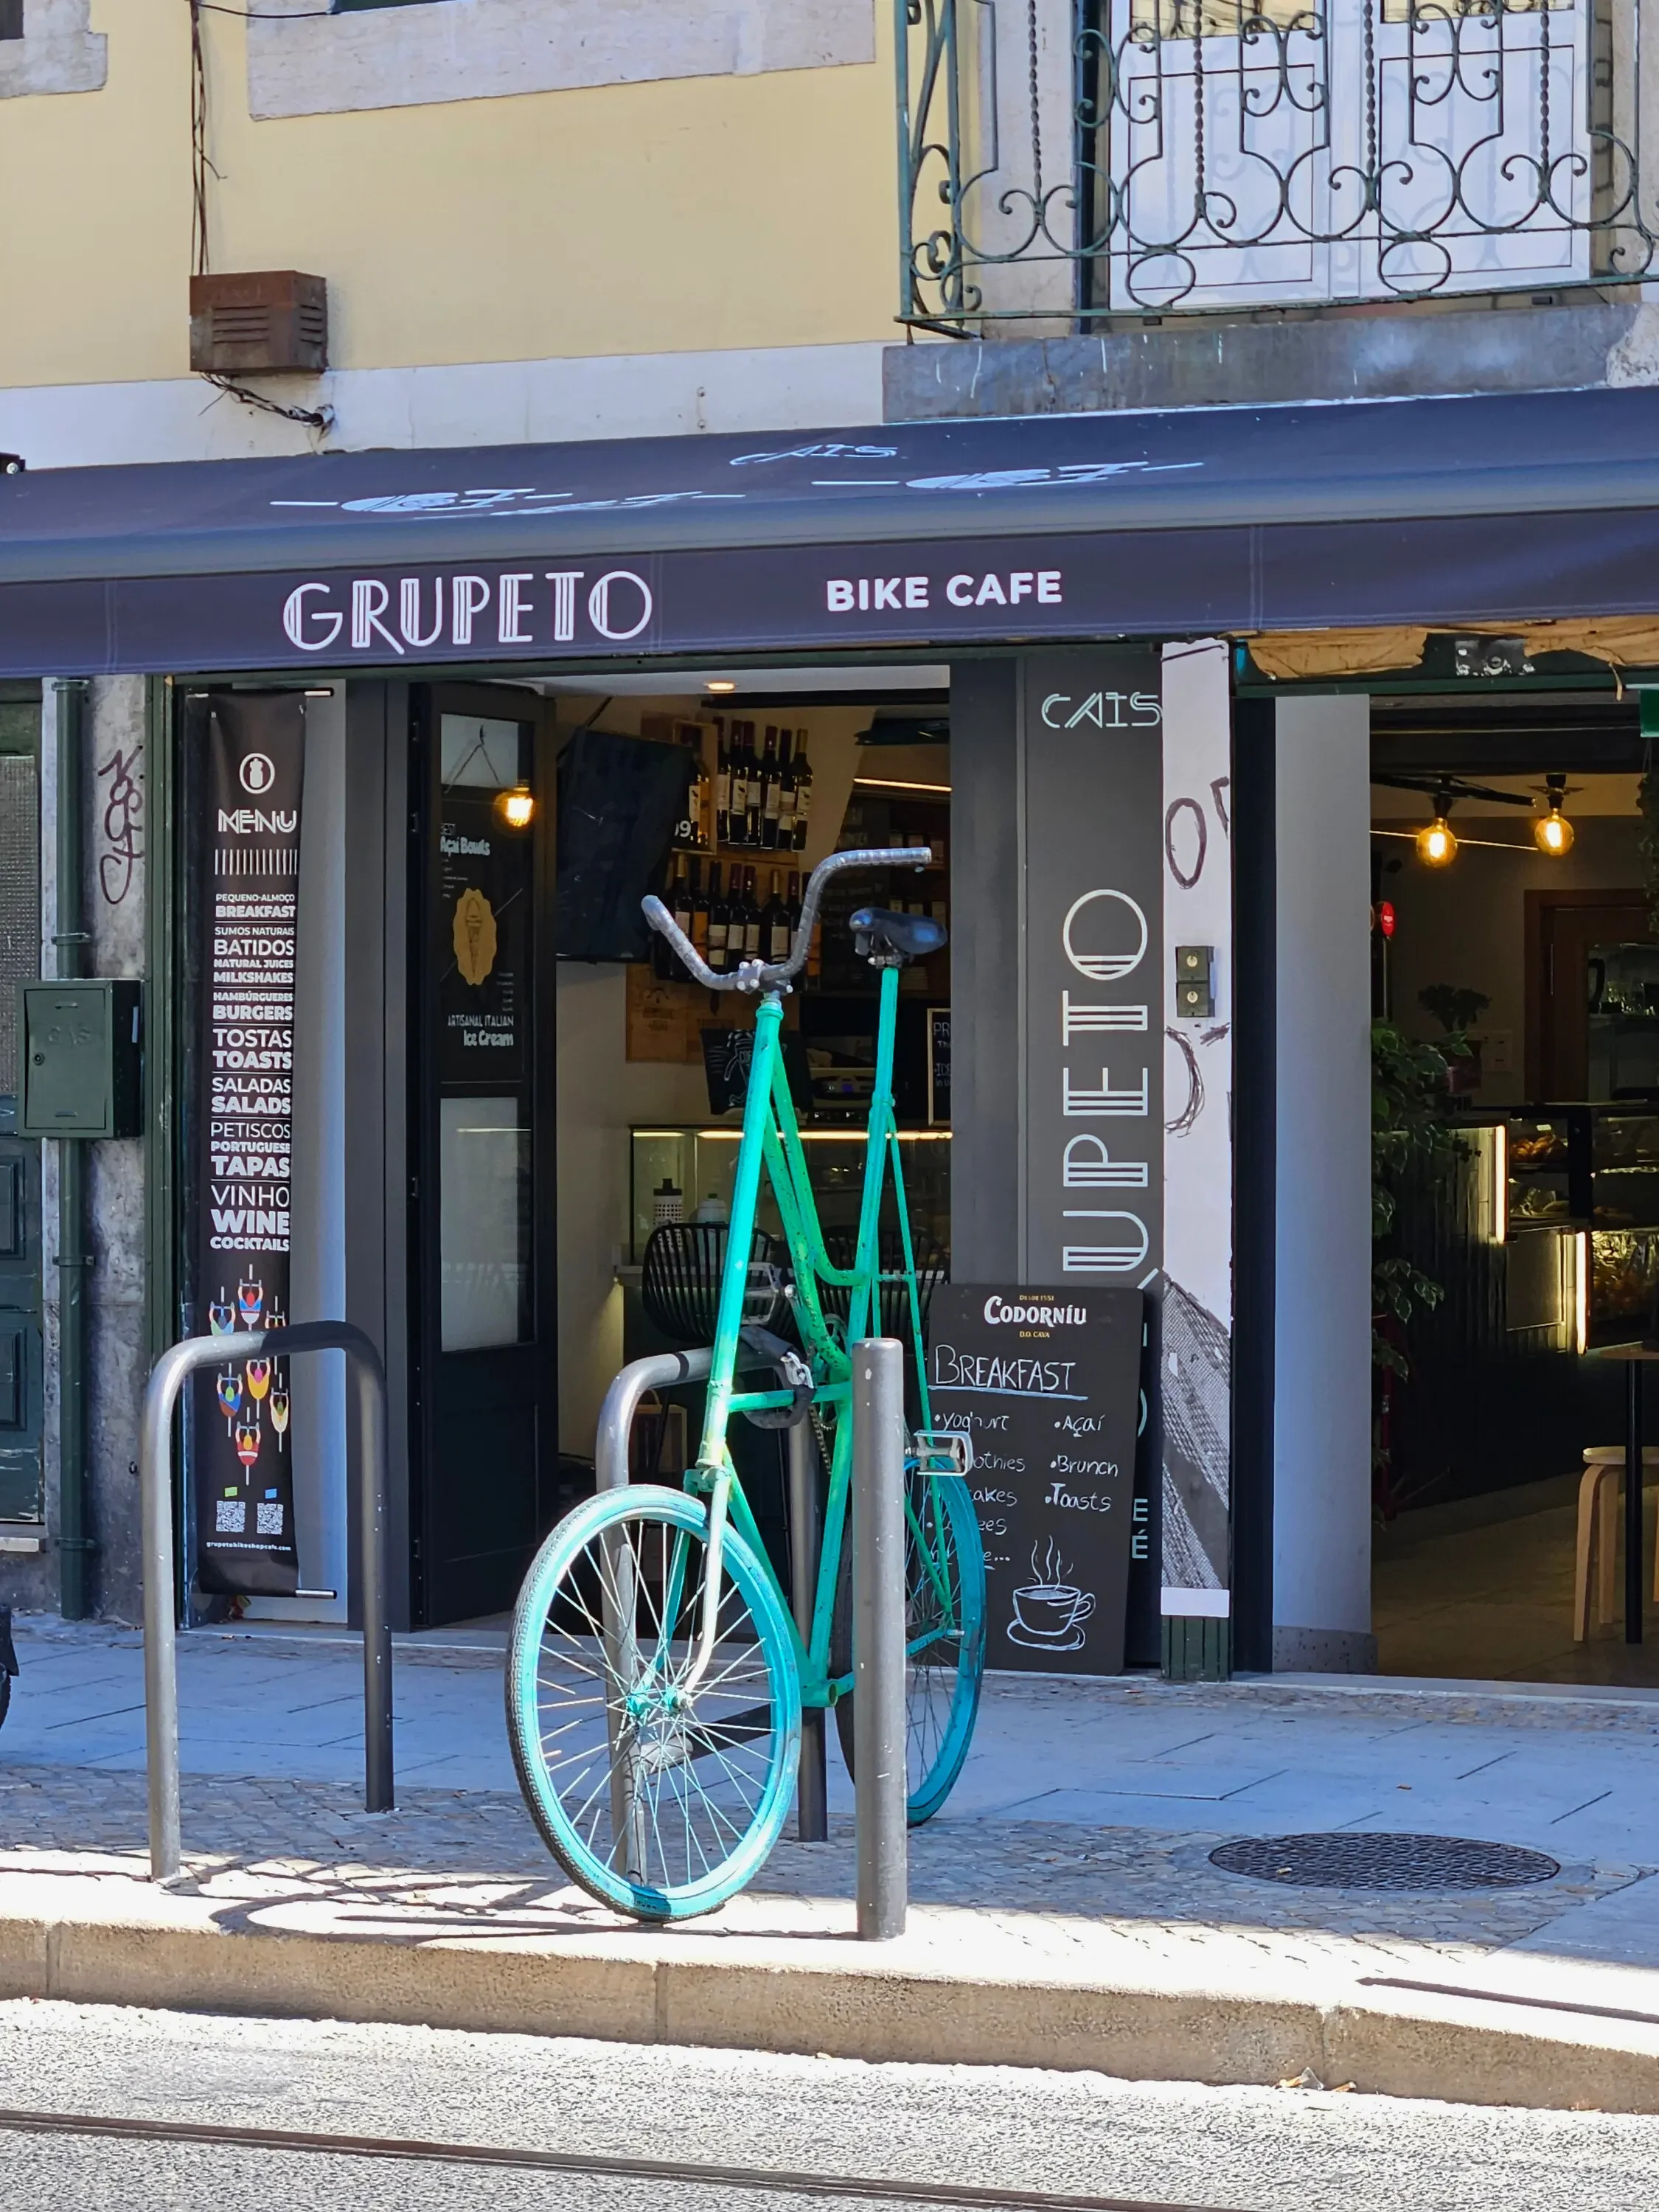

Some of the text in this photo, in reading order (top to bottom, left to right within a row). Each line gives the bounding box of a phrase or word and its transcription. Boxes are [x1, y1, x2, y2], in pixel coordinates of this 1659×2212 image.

[827, 570, 1062, 612] BIKE CAFE
[283, 571, 653, 654] GRUPETO
[1041, 691, 1163, 729] CAIS
[218, 808, 297, 834] MENU
[215, 893, 295, 904] PEQUENO-ALMOÇO
[215, 905, 296, 918] BREAKFAST
[215, 926, 294, 936] SUMOS NATURAIS
[214, 939, 294, 956] BATIDOS
[213, 959, 293, 969] NATURAL JUICES
[213, 971, 293, 984] MILKSHAKES
[213, 990, 293, 1002] HAMBÚRGUERES
[212, 1004, 293, 1020] BURGERS
[448, 1014, 514, 1027] ARTISANAL ITALIAN
[212, 1029, 292, 1048] TOSTAS
[463, 1029, 514, 1047] Ice Cream
[212, 1050, 292, 1070] TOASTS
[212, 1077, 291, 1094] SALADAS
[211, 1096, 291, 1115] SALADS
[211, 1121, 291, 1139] PETISCOS
[211, 1141, 291, 1154] PORTUGUESE
[211, 1155, 290, 1178] TAPAS
[211, 1184, 290, 1208] VINHO
[210, 1208, 290, 1236] WINE
[210, 1236, 289, 1252] COCKTAILS
[984, 1295, 1087, 1326] CODORNÍU
[935, 1344, 1076, 1391] BREAKFAST
[1057, 1454, 1119, 1477] Brunch
[1050, 1482, 1112, 1512] Toasts
